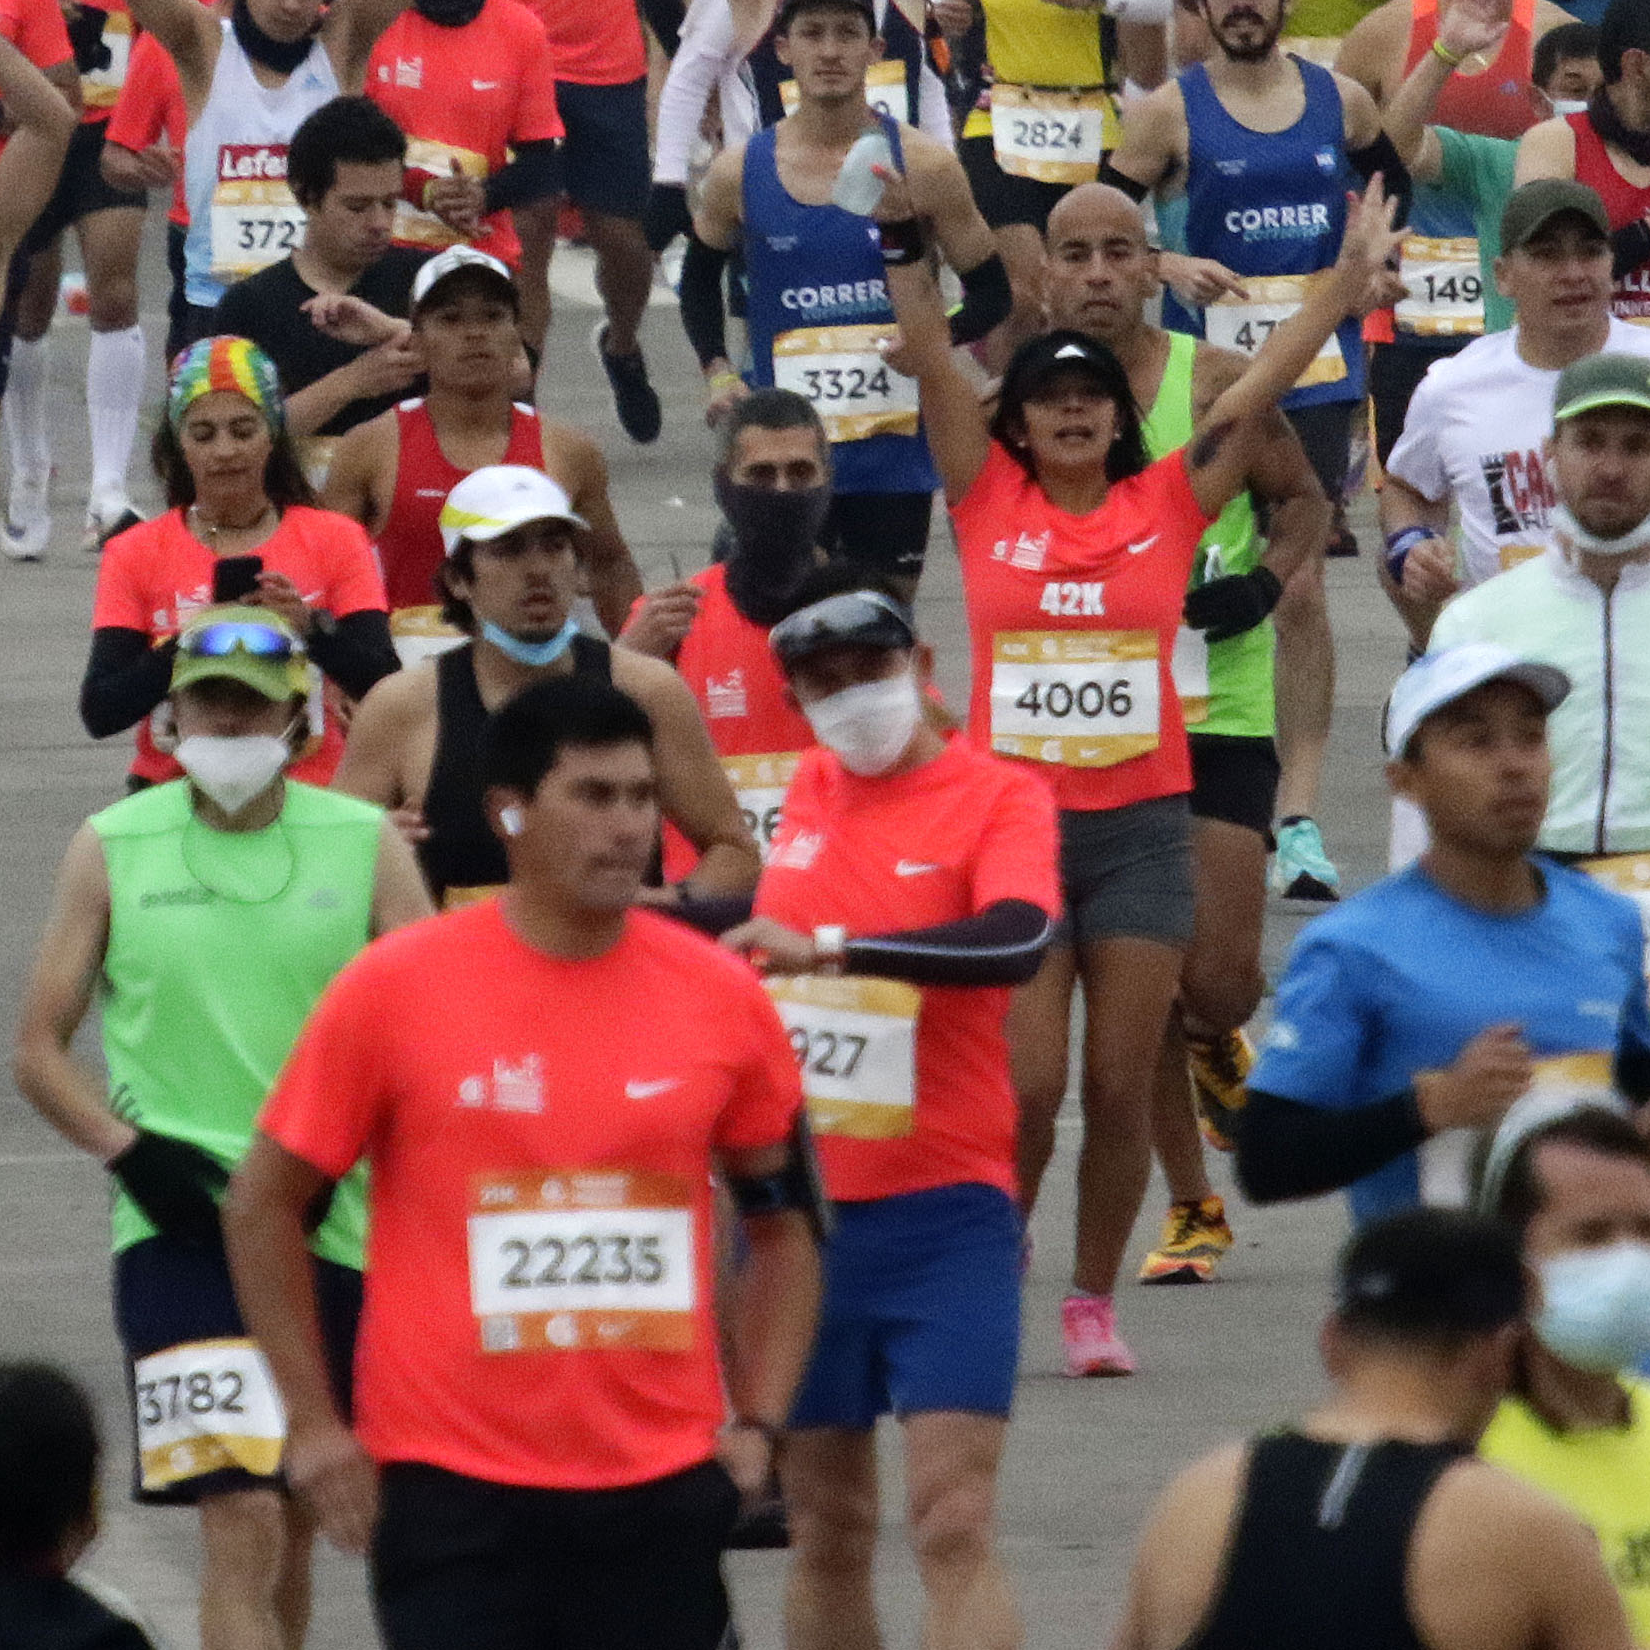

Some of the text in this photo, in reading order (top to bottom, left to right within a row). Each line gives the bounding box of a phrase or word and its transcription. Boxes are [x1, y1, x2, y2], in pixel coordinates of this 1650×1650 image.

[1012, 120, 1082, 150] 2824
[1224, 203, 1330, 234] CORRER
[780, 279, 890, 310] CORRER
[1424, 274, 1483, 304] 149
[1234, 319, 1277, 352] 47
[804, 366, 892, 403] 3324
[1039, 581, 1106, 617] 42K
[1014, 678, 1133, 719] 4006
[791, 1025, 868, 1078] 927
[500, 1233, 665, 1289] 22235
[136, 1370, 245, 1428] 3782
